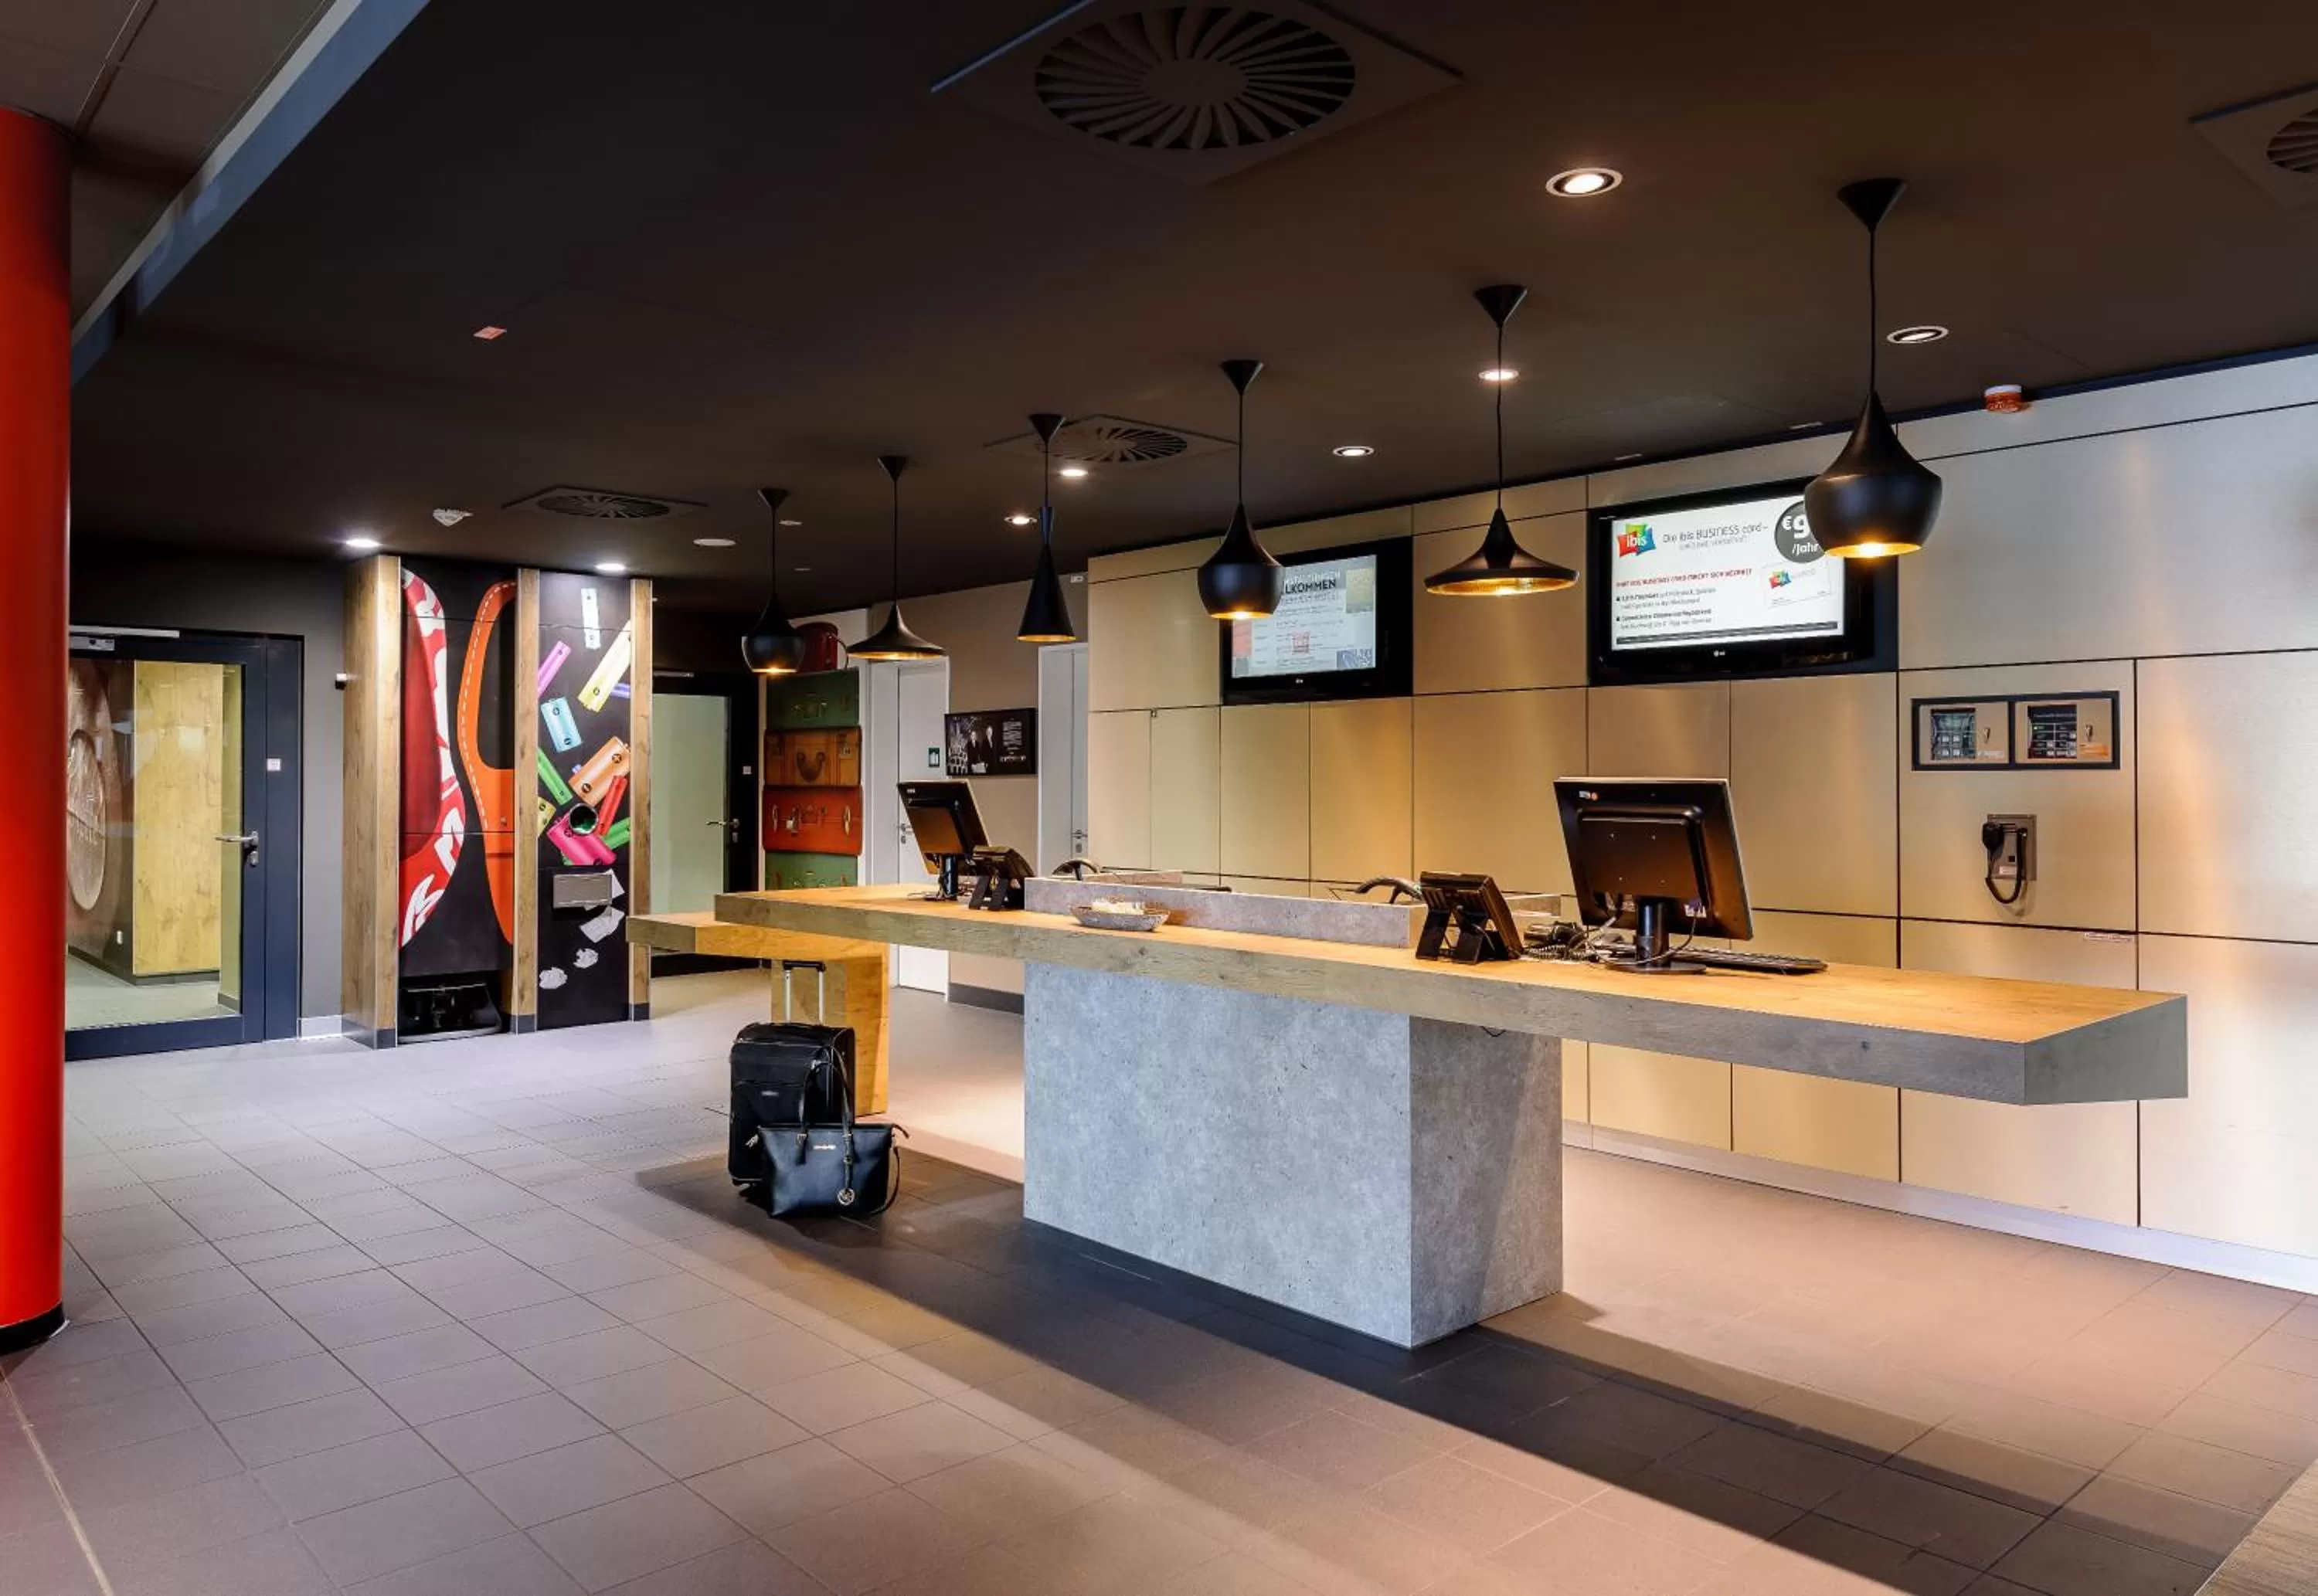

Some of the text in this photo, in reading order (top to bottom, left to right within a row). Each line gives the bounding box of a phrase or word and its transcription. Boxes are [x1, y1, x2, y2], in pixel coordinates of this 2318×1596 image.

[1782, 514, 1810, 539] €9
[1626, 533, 1647, 548] ibis
[1285, 579, 1336, 594] LKOMMEN
